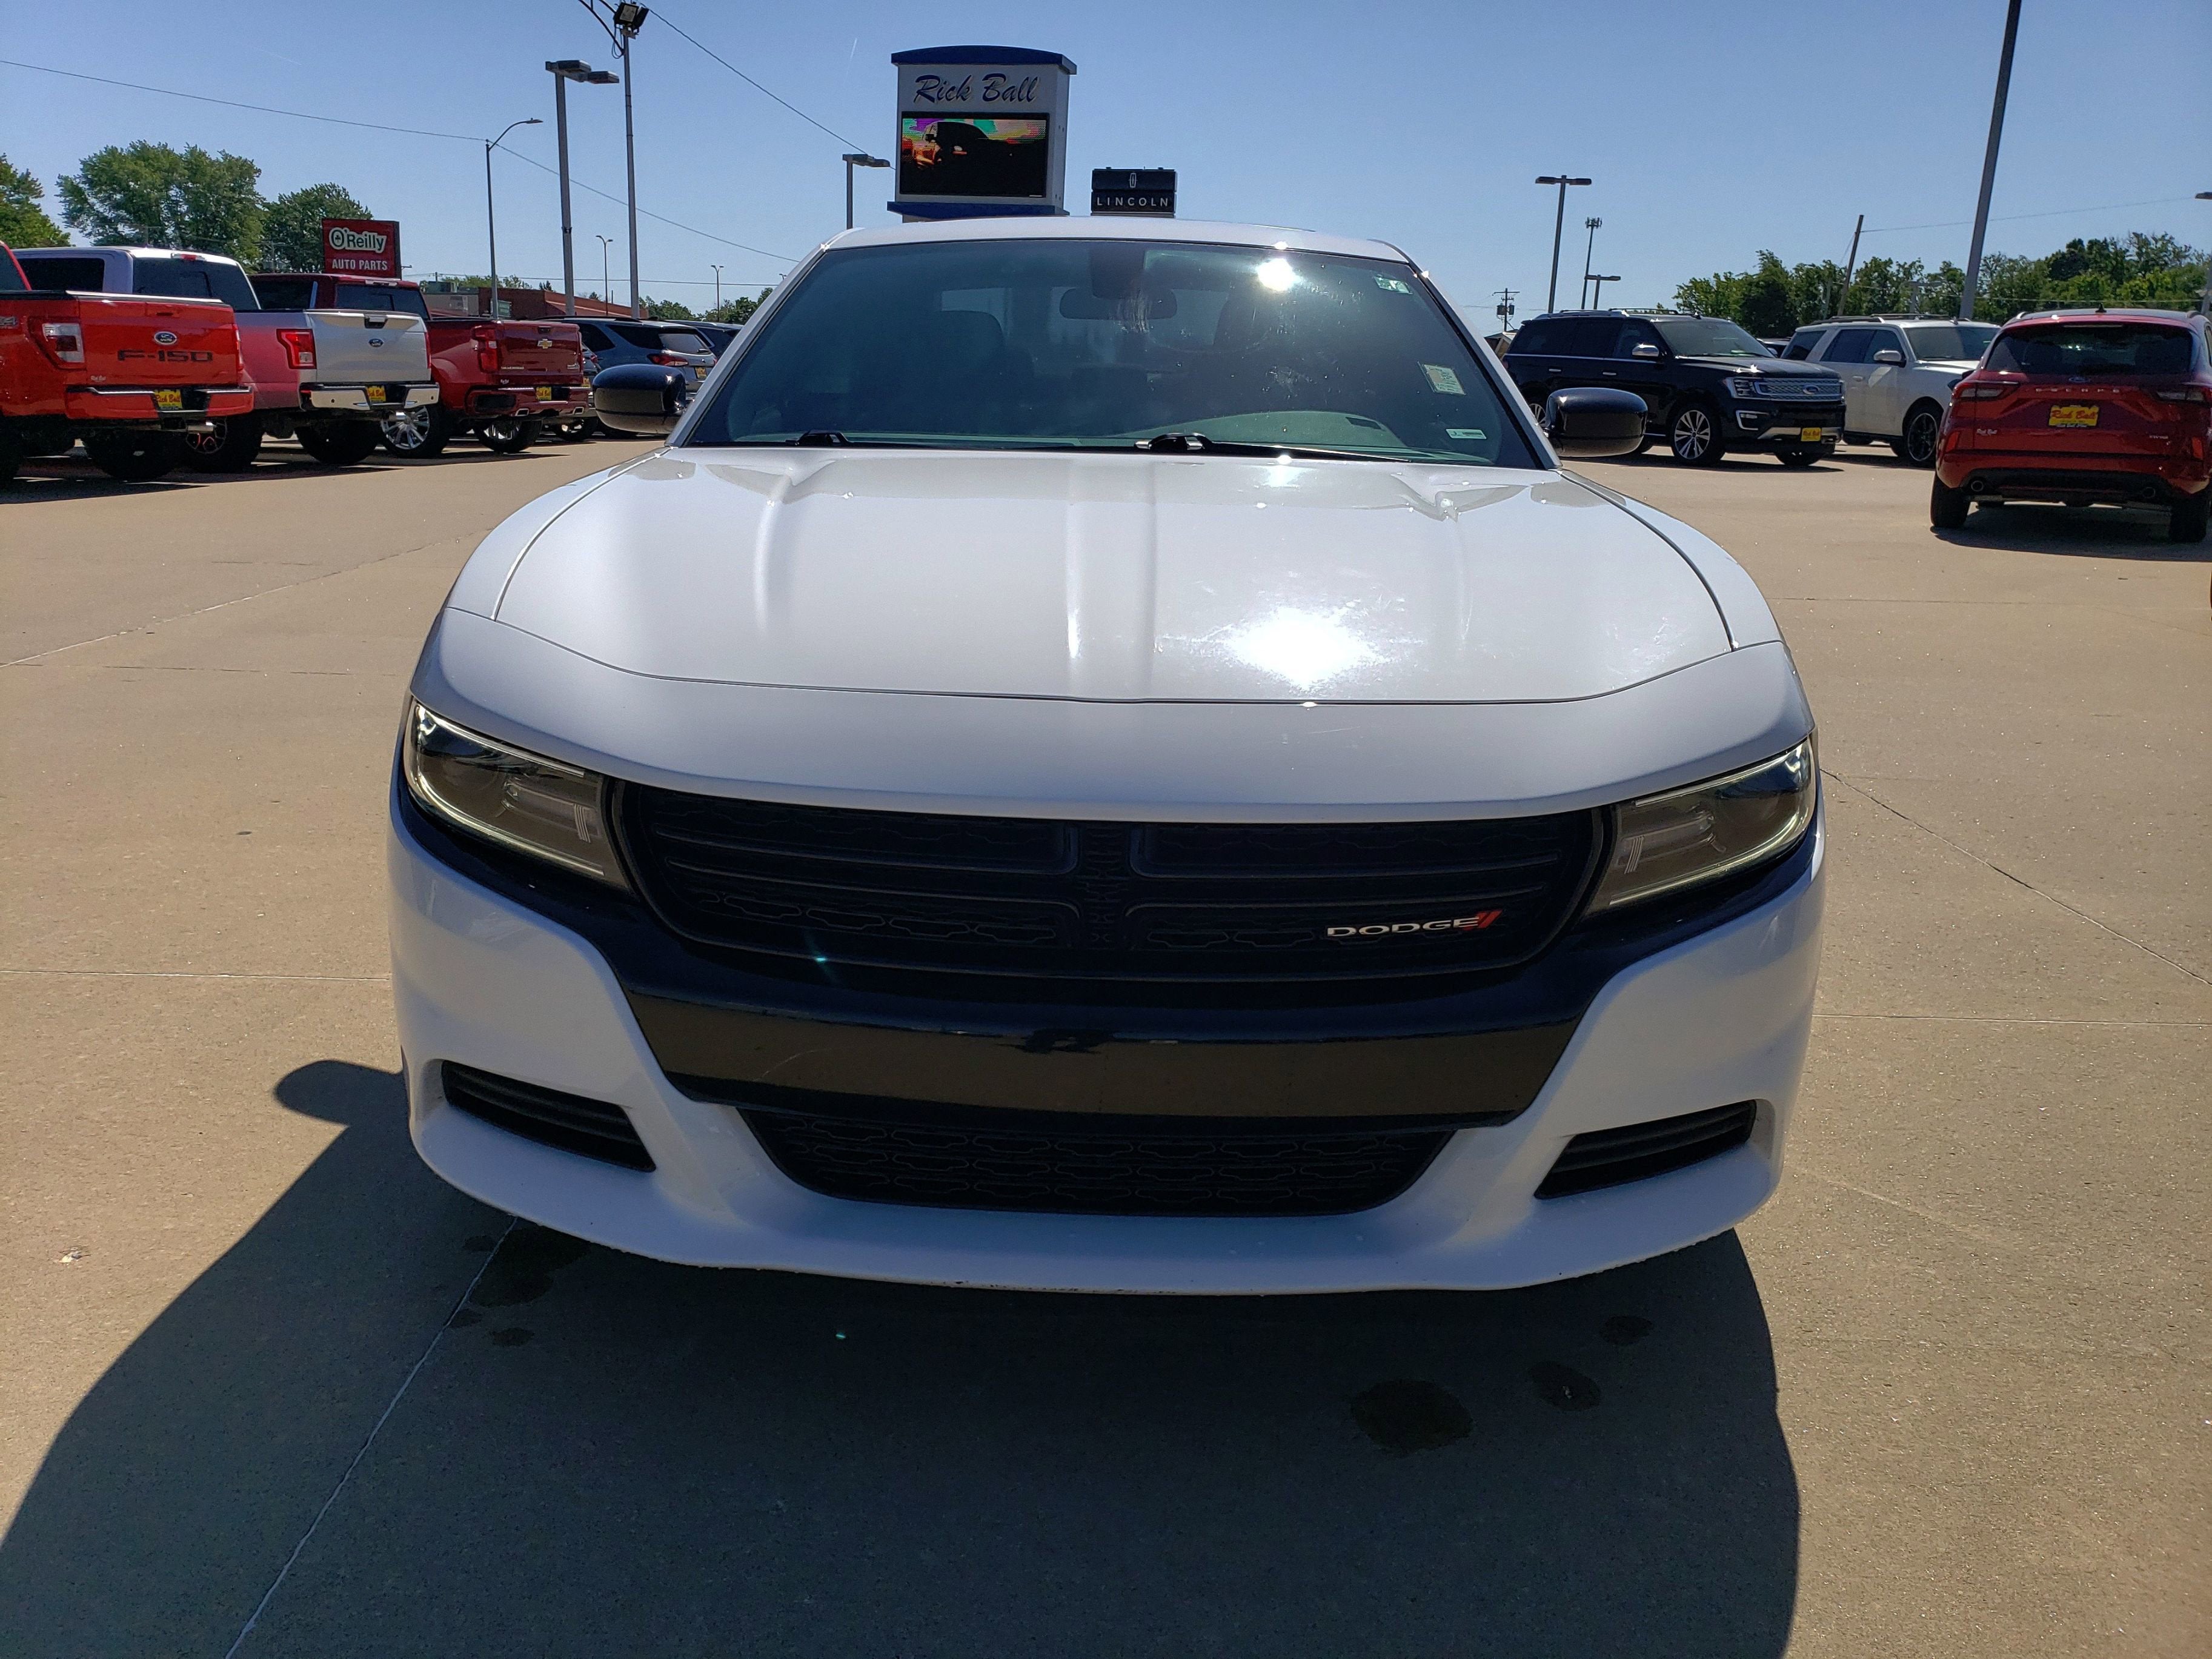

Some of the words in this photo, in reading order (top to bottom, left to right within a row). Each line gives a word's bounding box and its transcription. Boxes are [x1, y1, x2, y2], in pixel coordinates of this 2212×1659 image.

[913, 74, 972, 104] Rick
[981, 73, 1038, 103] Ball
[1097, 197, 1168, 207] LINCOLN
[330, 228, 385, 252] O'Reilly
[332, 259, 356, 270] AUTO
[359, 260, 388, 271] PARTS
[118, 349, 213, 362] F-150
[1327, 917, 1480, 937] DODGE
